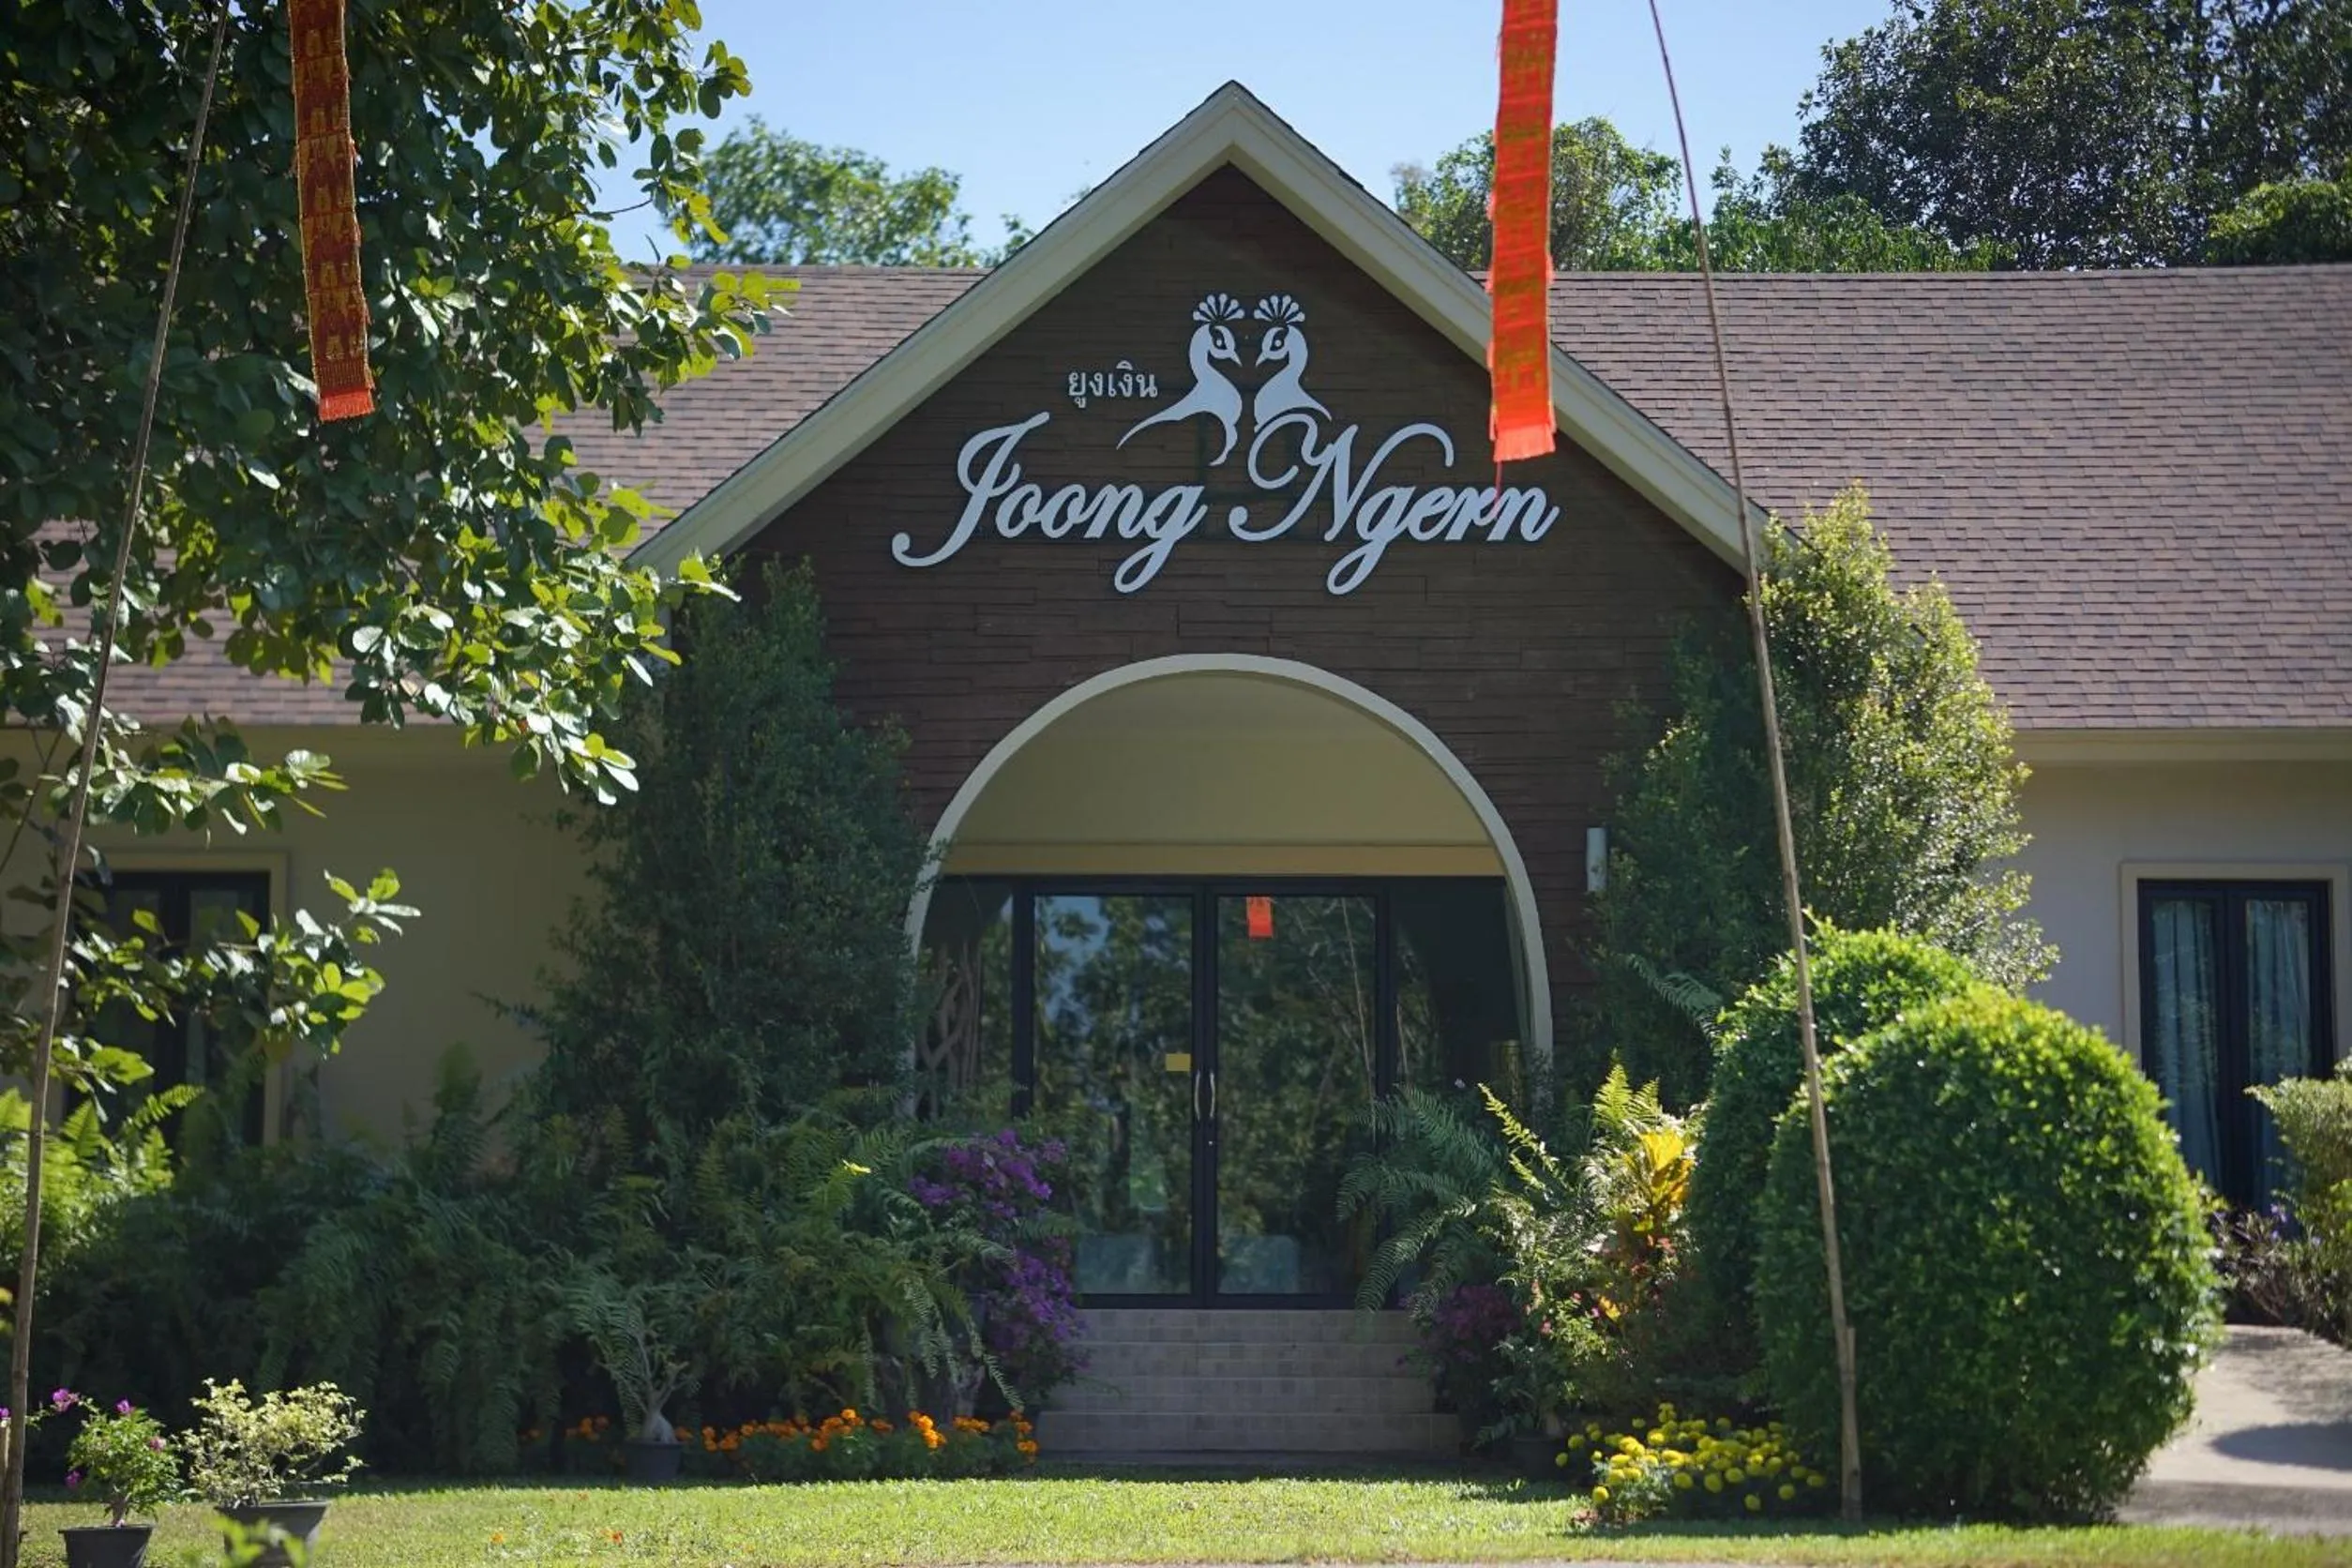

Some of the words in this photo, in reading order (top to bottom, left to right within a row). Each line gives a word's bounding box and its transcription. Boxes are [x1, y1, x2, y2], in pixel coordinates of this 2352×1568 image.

[1068, 360, 1158, 408] ยูงเงิน
[891, 411, 1208, 594] Joong
[1229, 413, 1560, 595] Ngern
